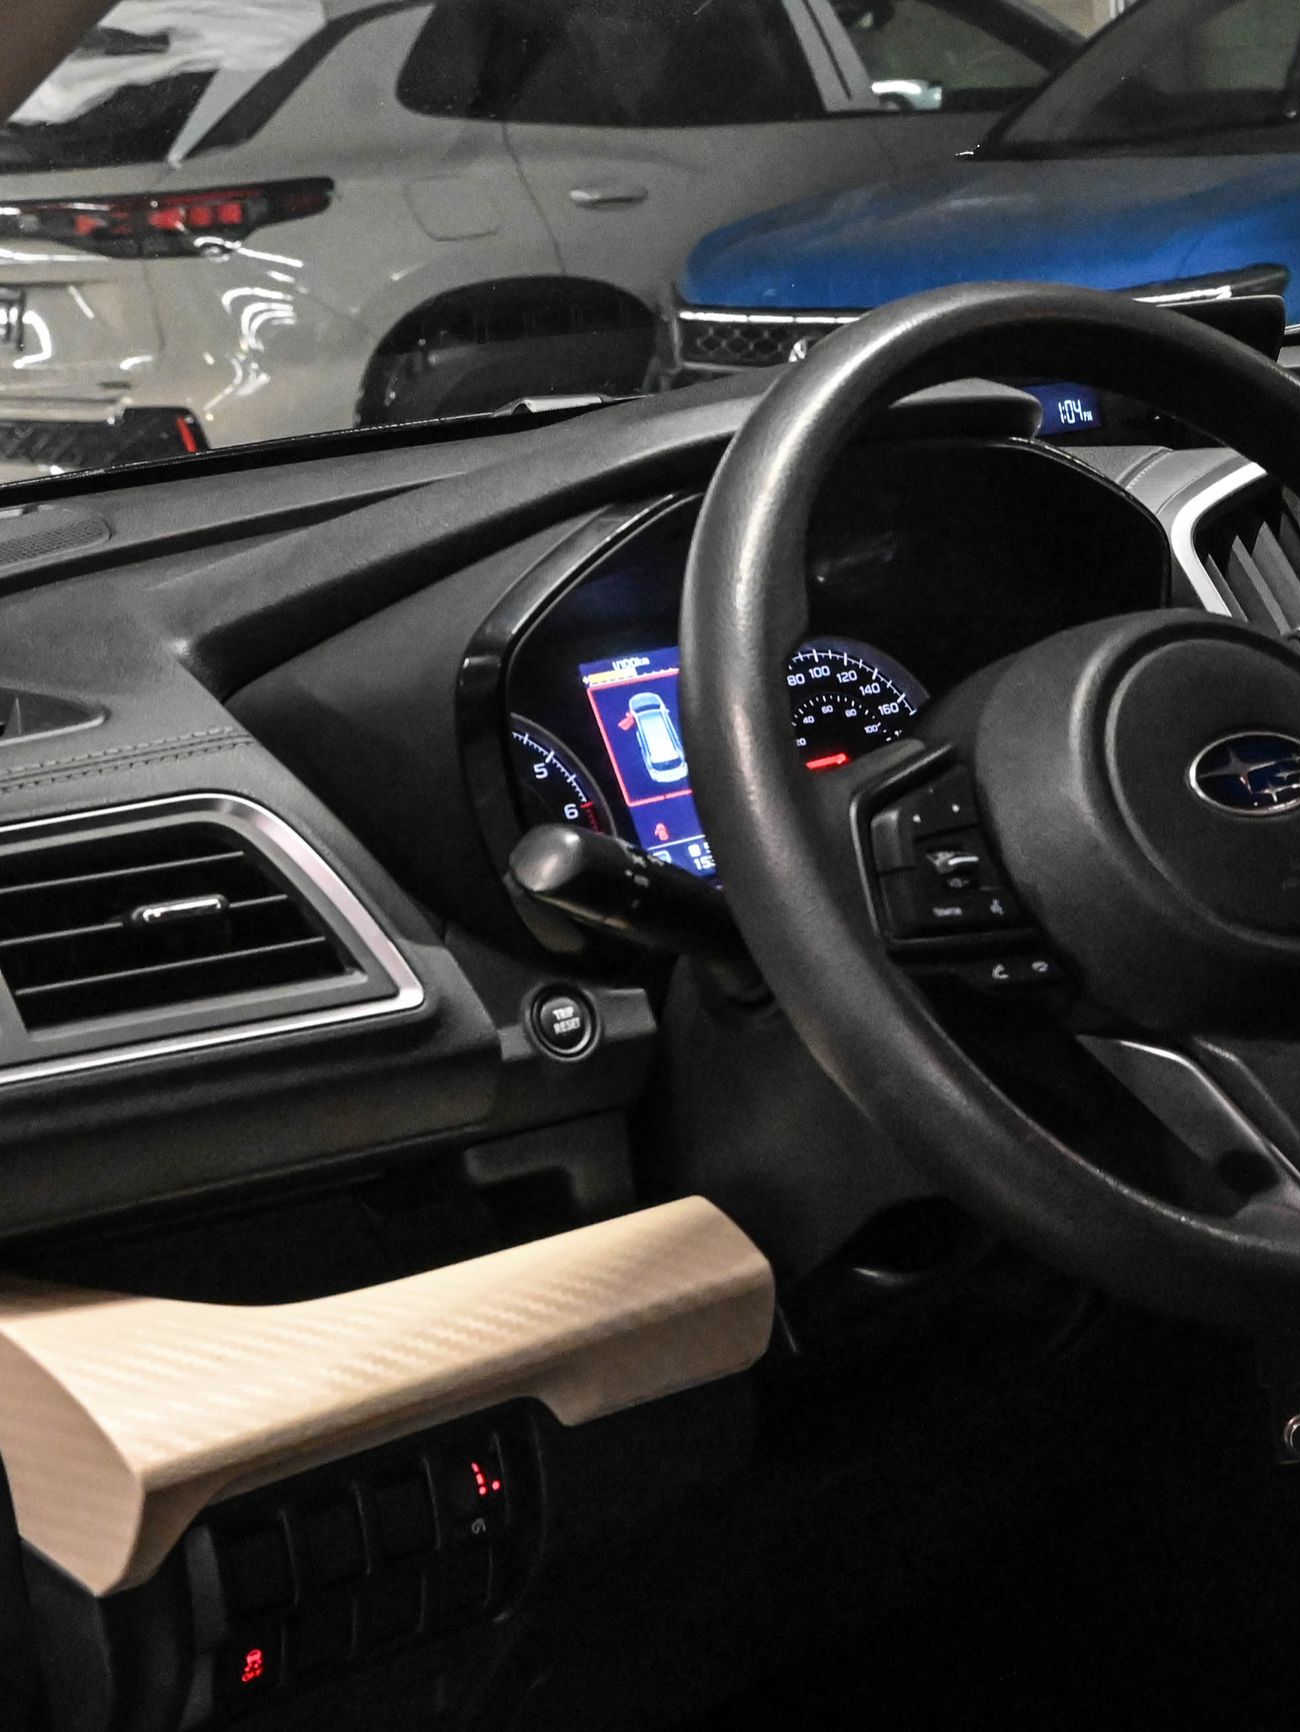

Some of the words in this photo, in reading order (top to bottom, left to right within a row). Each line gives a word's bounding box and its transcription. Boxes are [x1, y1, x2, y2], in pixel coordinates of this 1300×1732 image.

[1058, 399, 1083, 424] 1:04
[808, 665, 831, 679] 100
[836, 670, 857, 684] 120
[786, 673, 806, 687] 80
[859, 682, 881, 696] 140
[821, 704, 834, 714] 60
[844, 708, 857, 718] 80
[878, 702, 900, 716] 160
[802, 715, 815, 724] 40
[863, 724, 879, 734] 100
[533, 763, 548, 779] 5
[564, 804, 579, 820] 6
